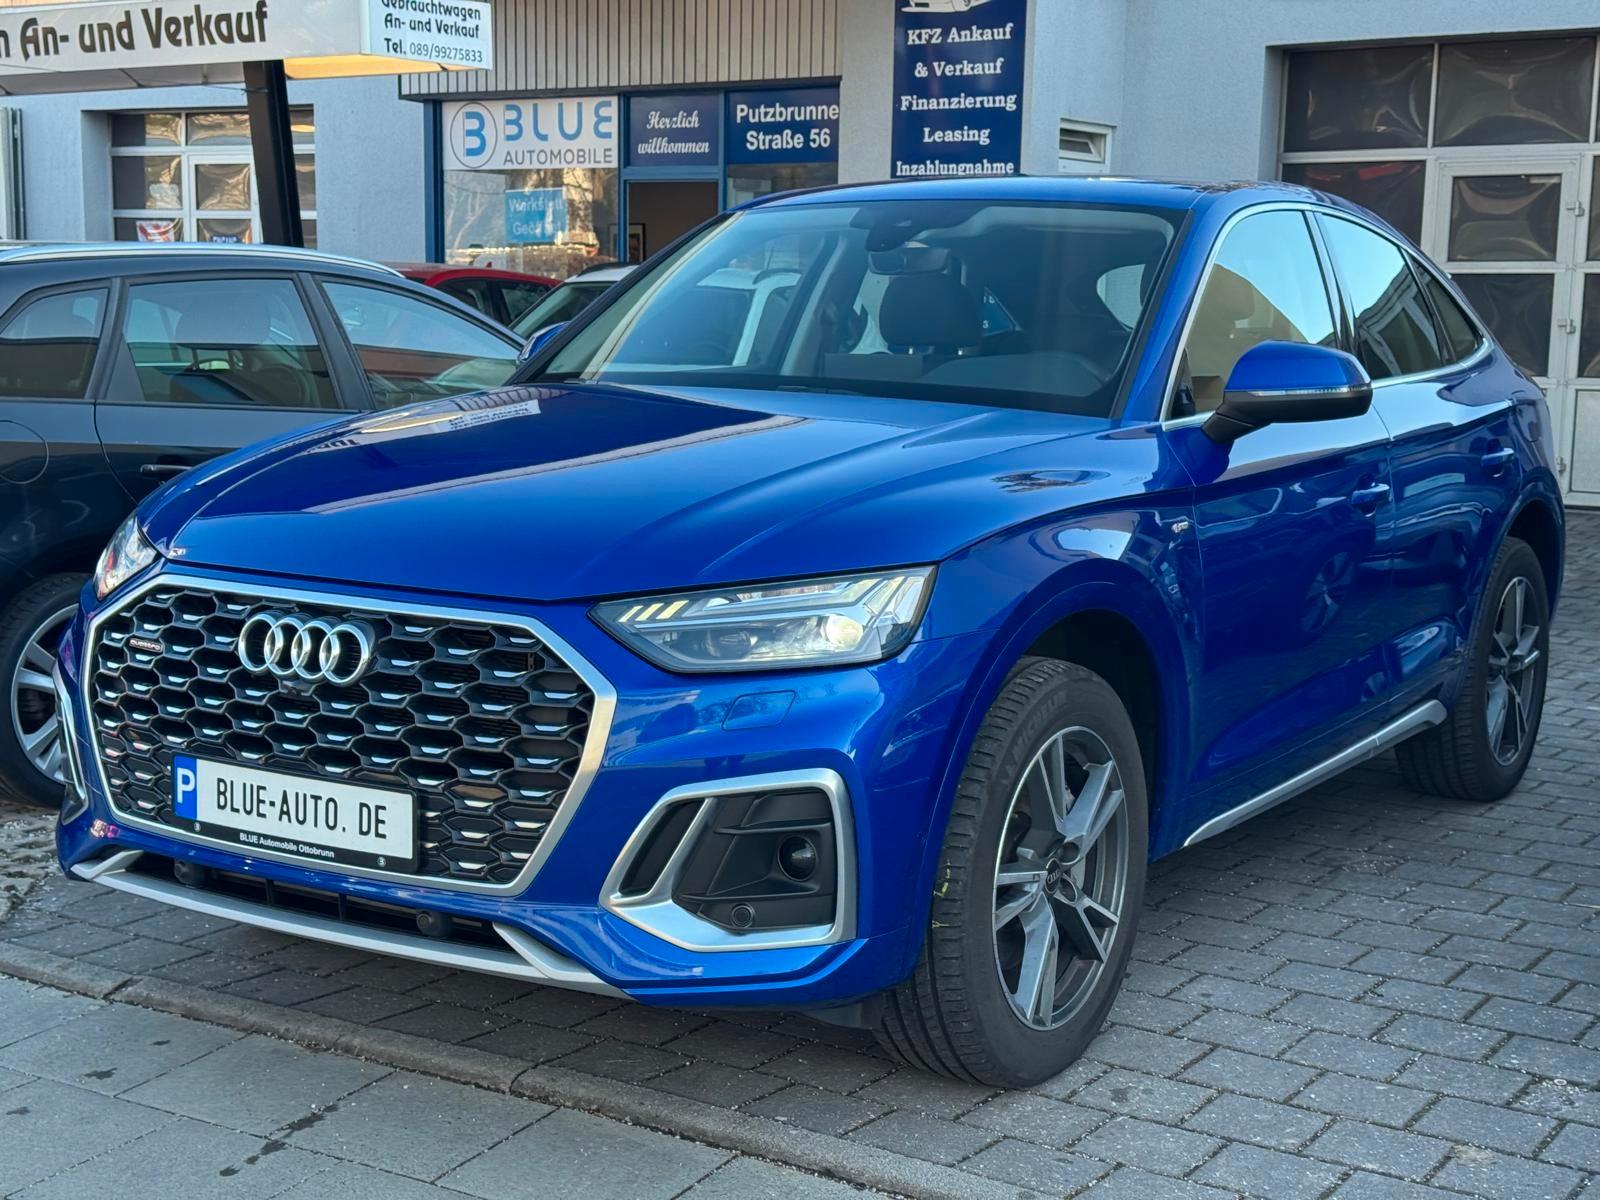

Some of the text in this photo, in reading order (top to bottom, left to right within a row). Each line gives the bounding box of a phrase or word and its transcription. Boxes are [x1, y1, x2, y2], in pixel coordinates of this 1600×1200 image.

[20, 17, 70, 61] An-
[78, 10, 135, 54] und
[140, 0, 268, 49] Verkauf
[384, 13, 479, 38] An- und Verkauf
[907, 23, 1014, 45] KFZ Ankauf
[384, 38, 483, 63] Tel. 089/99275833
[914, 58, 1004, 78] & Verkauf
[900, 93, 1017, 112] Finanzierung
[503, 101, 612, 142] BLUE
[646, 110, 700, 129] Herzlich
[736, 103, 839, 124] Putzbrunne
[637, 137, 710, 155] willkommen
[746, 128, 831, 150] Straße 56
[923, 126, 991, 145] Leasing
[503, 148, 613, 165] AUTOMOBILE
[896, 159, 1014, 176] Inzahlungnahme
[239, 832, 335, 859] BLUE Automobile Ottobrunn
